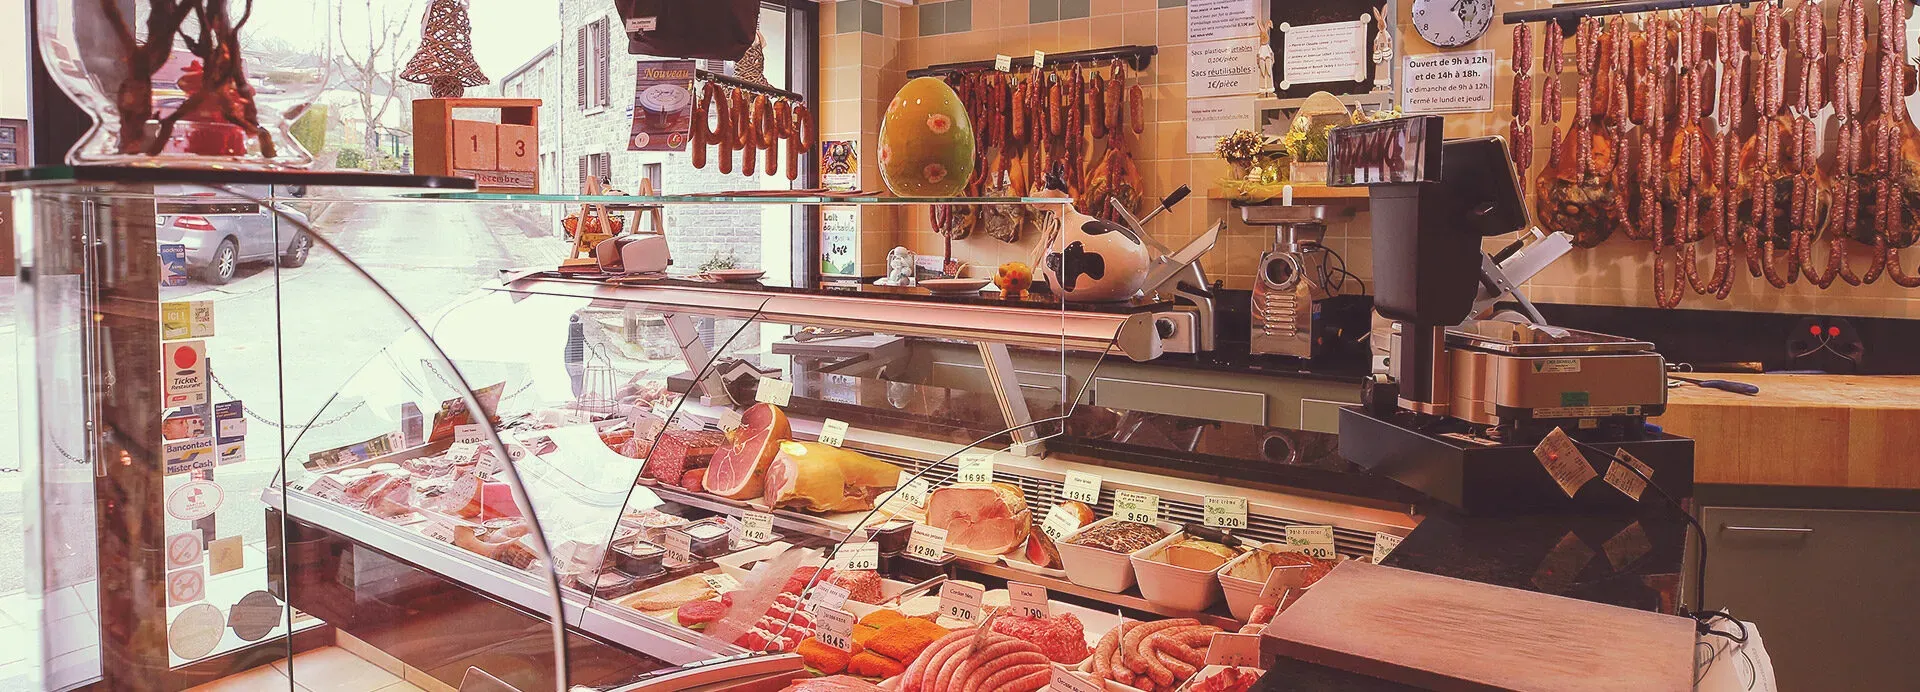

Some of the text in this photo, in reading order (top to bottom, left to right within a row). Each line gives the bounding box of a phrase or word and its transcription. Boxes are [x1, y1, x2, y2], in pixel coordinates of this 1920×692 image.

[1204, 47, 1230, 56] plastique
[1409, 56, 1488, 68] Ouvert de 9h à 12h
[643, 67, 689, 79] Nouveau
[1191, 69, 1207, 78] Sacs
[1207, 65, 1252, 76] réutilisables
[1415, 69, 1481, 81] et de 14h à 18h.
[1207, 80, 1239, 89] 1€/pièce
[1414, 85, 1447, 93] dimanche
[1458, 83, 1467, 91] 9h
[1409, 97, 1431, 105] Fermé
[1465, 95, 1485, 104] jeudi.
[470, 134, 526, 158] 1 3
[173, 375, 198, 386] Ticket
[166, 439, 213, 454] Bancontact
[167, 459, 213, 474] Mister Cash
[1127, 512, 1149, 523] 9.50
[1218, 516, 1239, 527] 9.20
[848, 560, 870, 569] 8.40
[951, 606, 972, 620] 9.70
